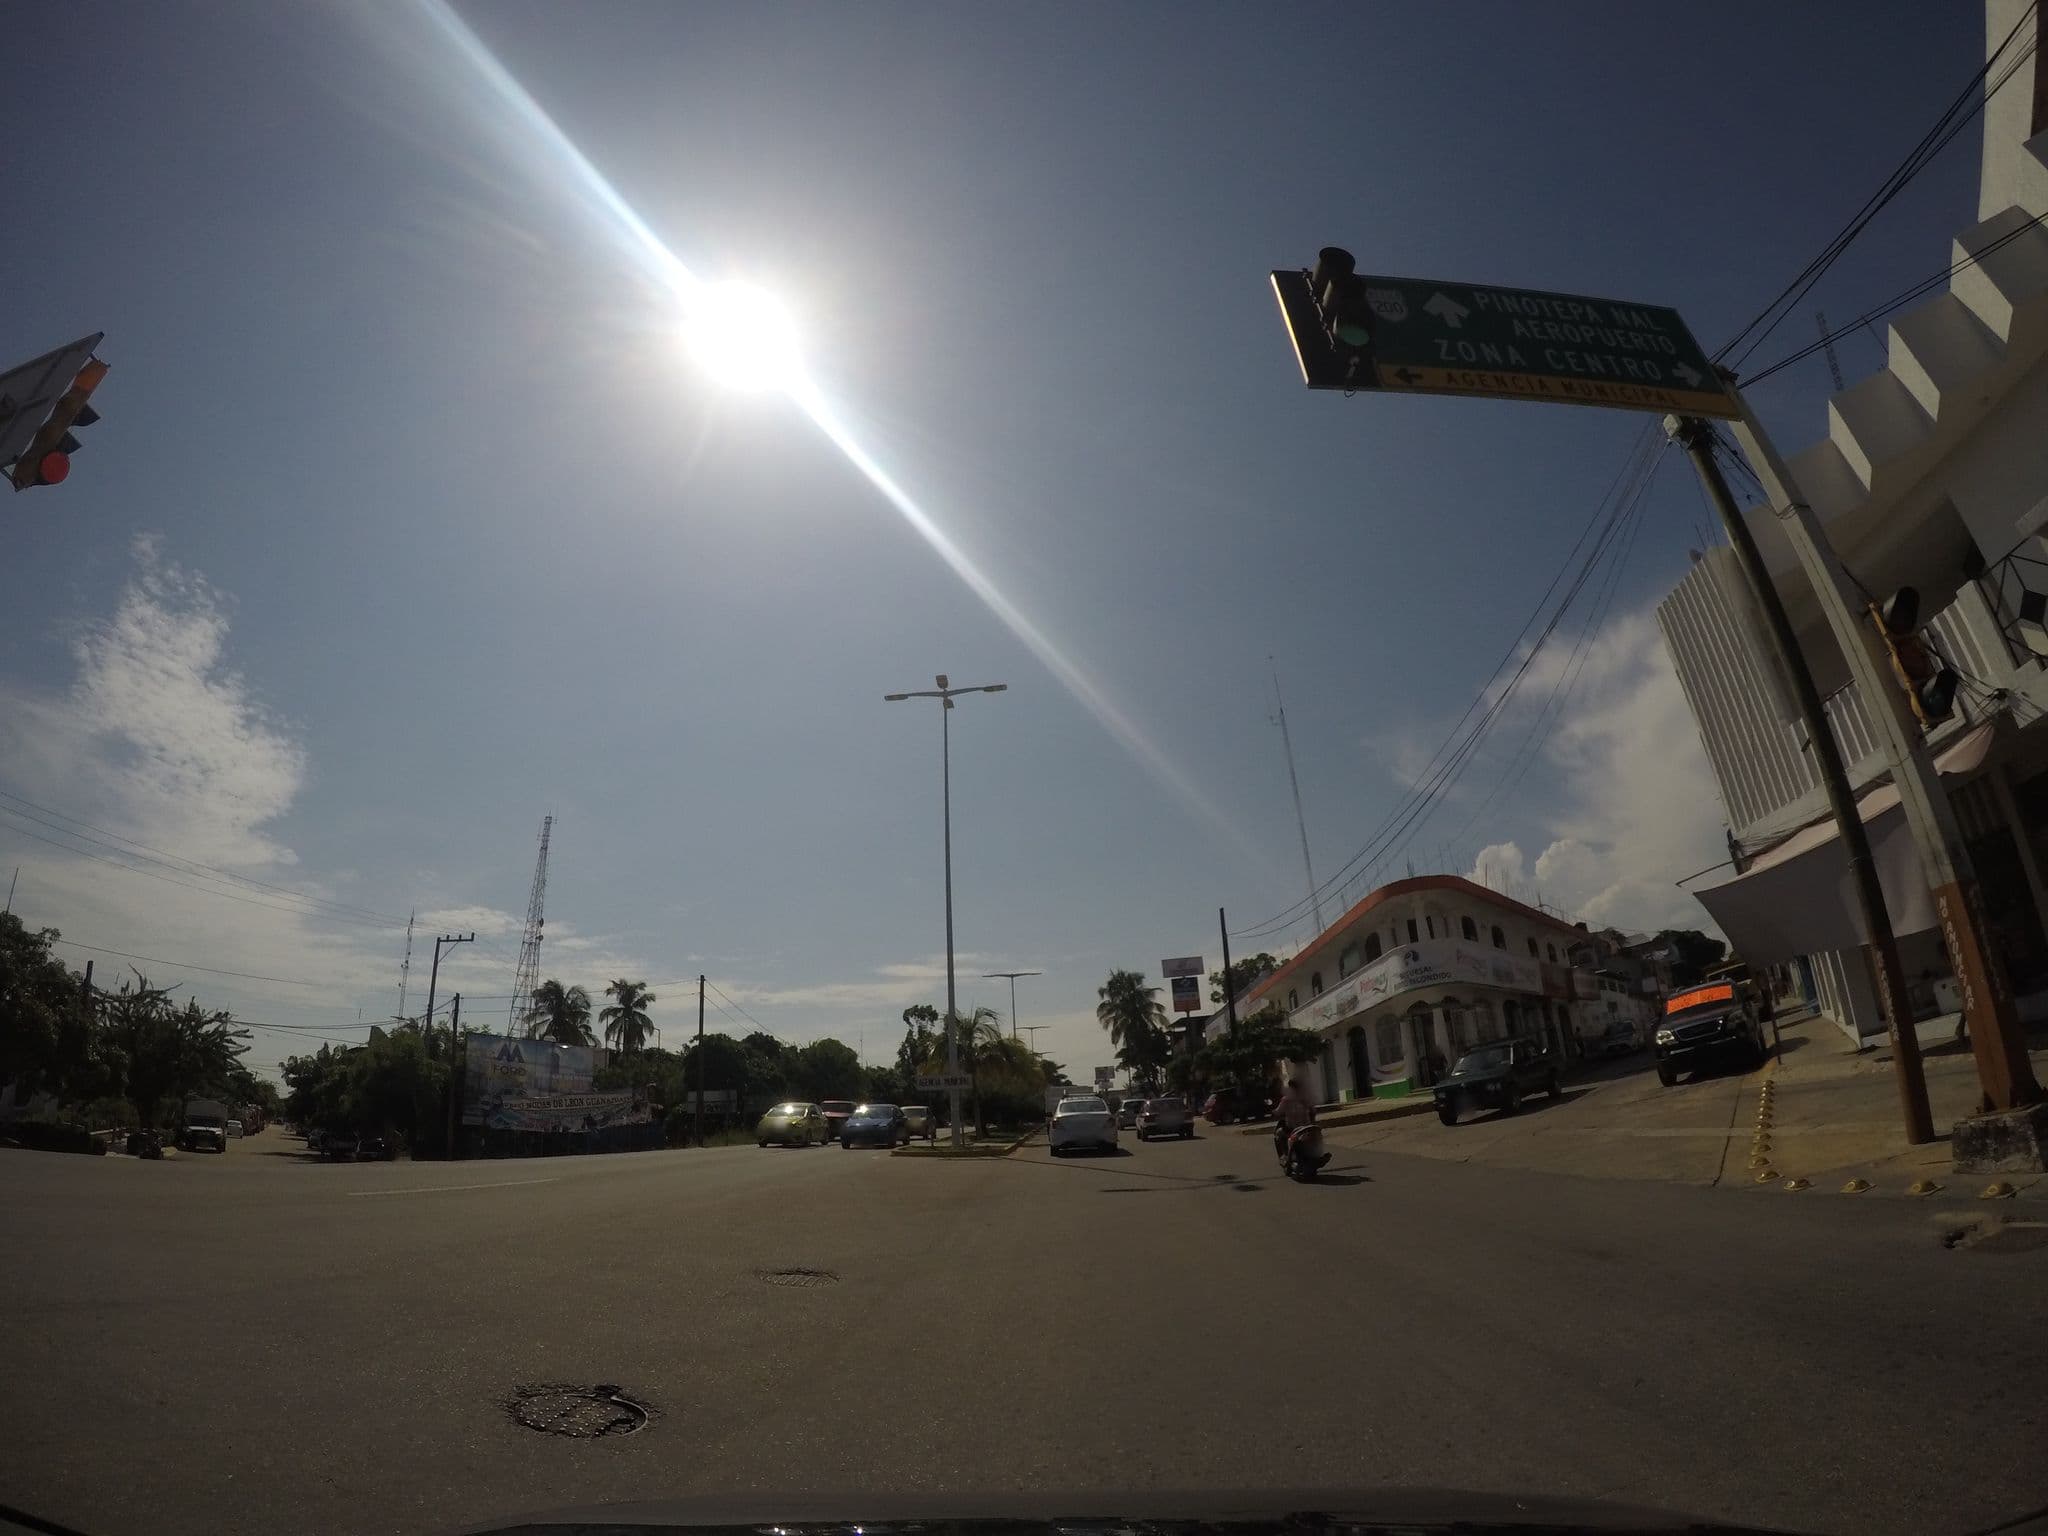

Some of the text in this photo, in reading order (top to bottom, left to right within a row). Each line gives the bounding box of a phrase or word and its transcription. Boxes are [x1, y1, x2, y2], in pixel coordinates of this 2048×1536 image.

[1377, 302, 1405, 315] 200
[1473, 291, 1603, 324] PINOTEPA
[1513, 319, 1676, 356] AEROPUERTO
[1434, 339, 1662, 381] ZONA CENTRO
[1447, 371, 1681, 406] AGENCIA MUNICIPAL
[1938, 895, 1949, 918] NO
